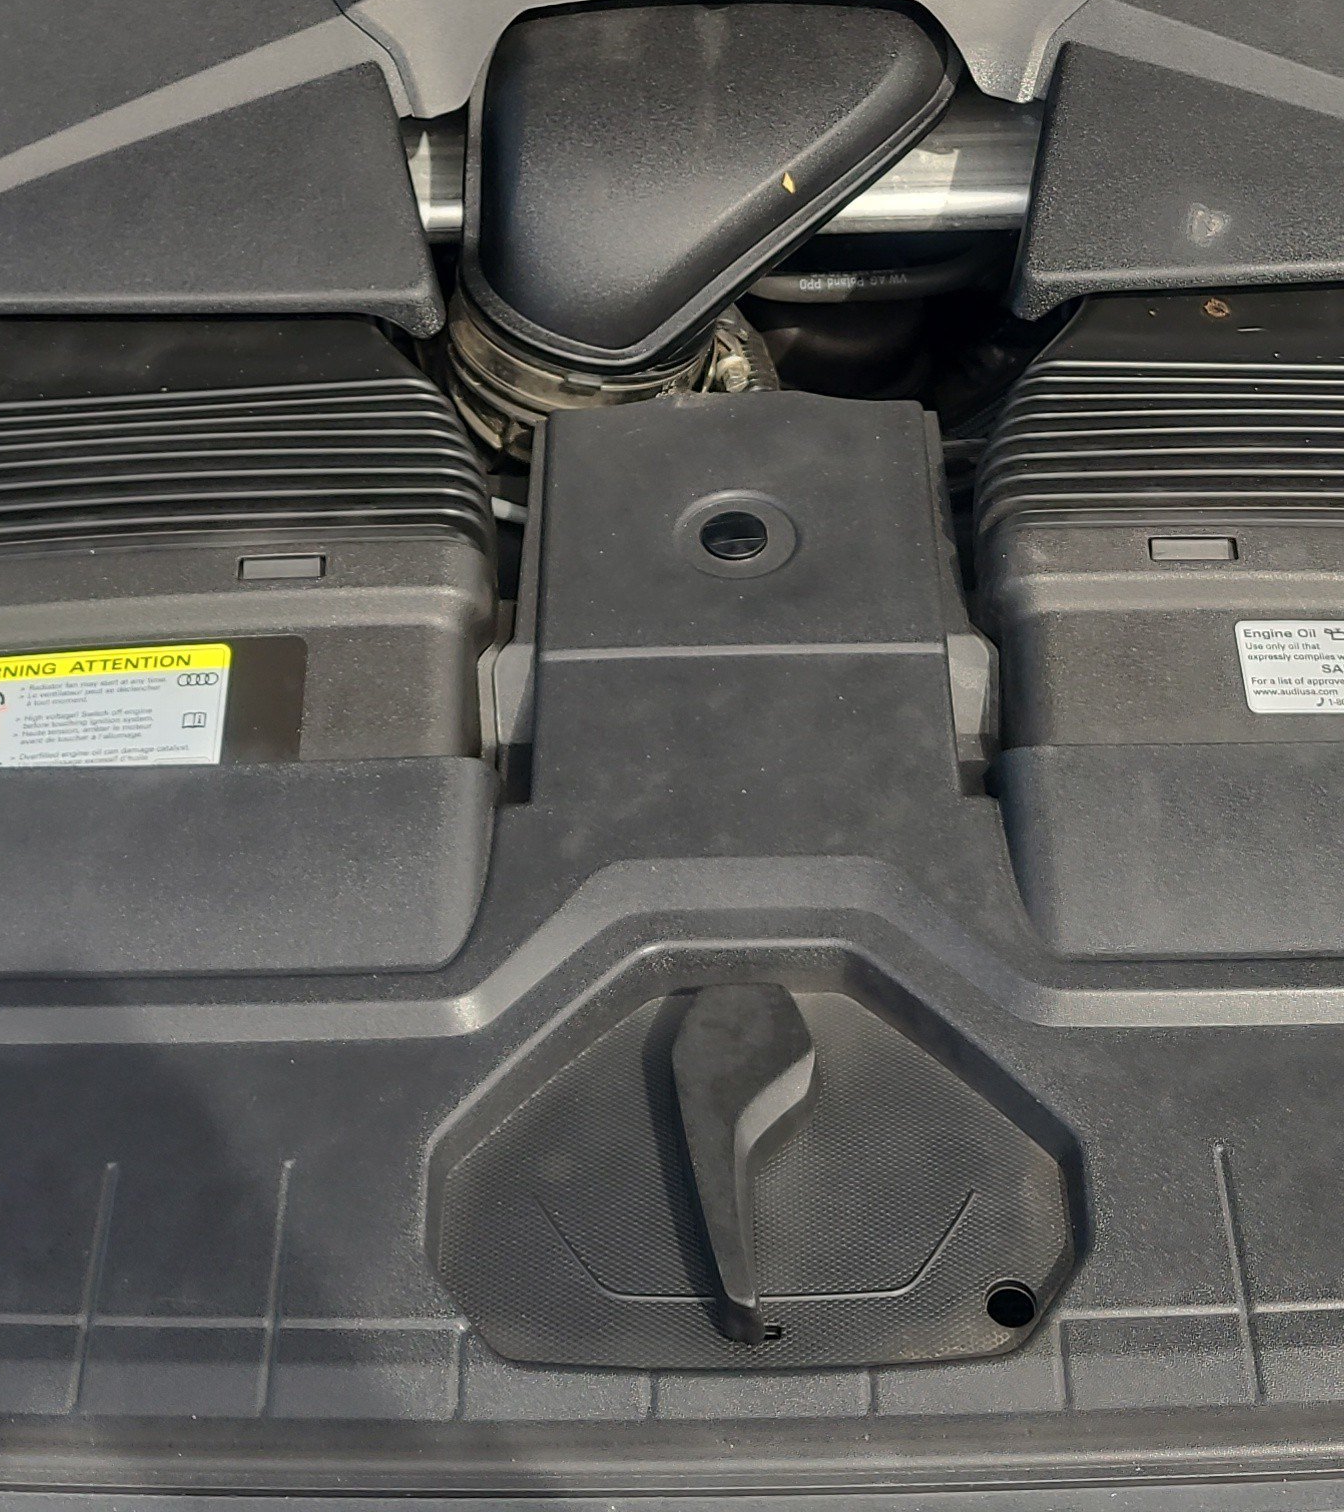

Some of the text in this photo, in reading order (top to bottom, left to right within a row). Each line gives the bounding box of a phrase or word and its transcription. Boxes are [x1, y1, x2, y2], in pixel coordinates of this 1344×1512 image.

[827, 277, 864, 288] Poland
[1243, 628, 1316, 639] Engine Oil
[1265, 642, 1286, 651] only
[1246, 652, 1291, 660] expressly
[1293, 652, 1335, 661] complies
[69, 653, 191, 674] ATTENTION
[1250, 676, 1267, 684] For
[1277, 676, 1292, 684] list
[1293, 676, 1305, 684] of
[1252, 686, 1338, 696] www.audiusa.com
